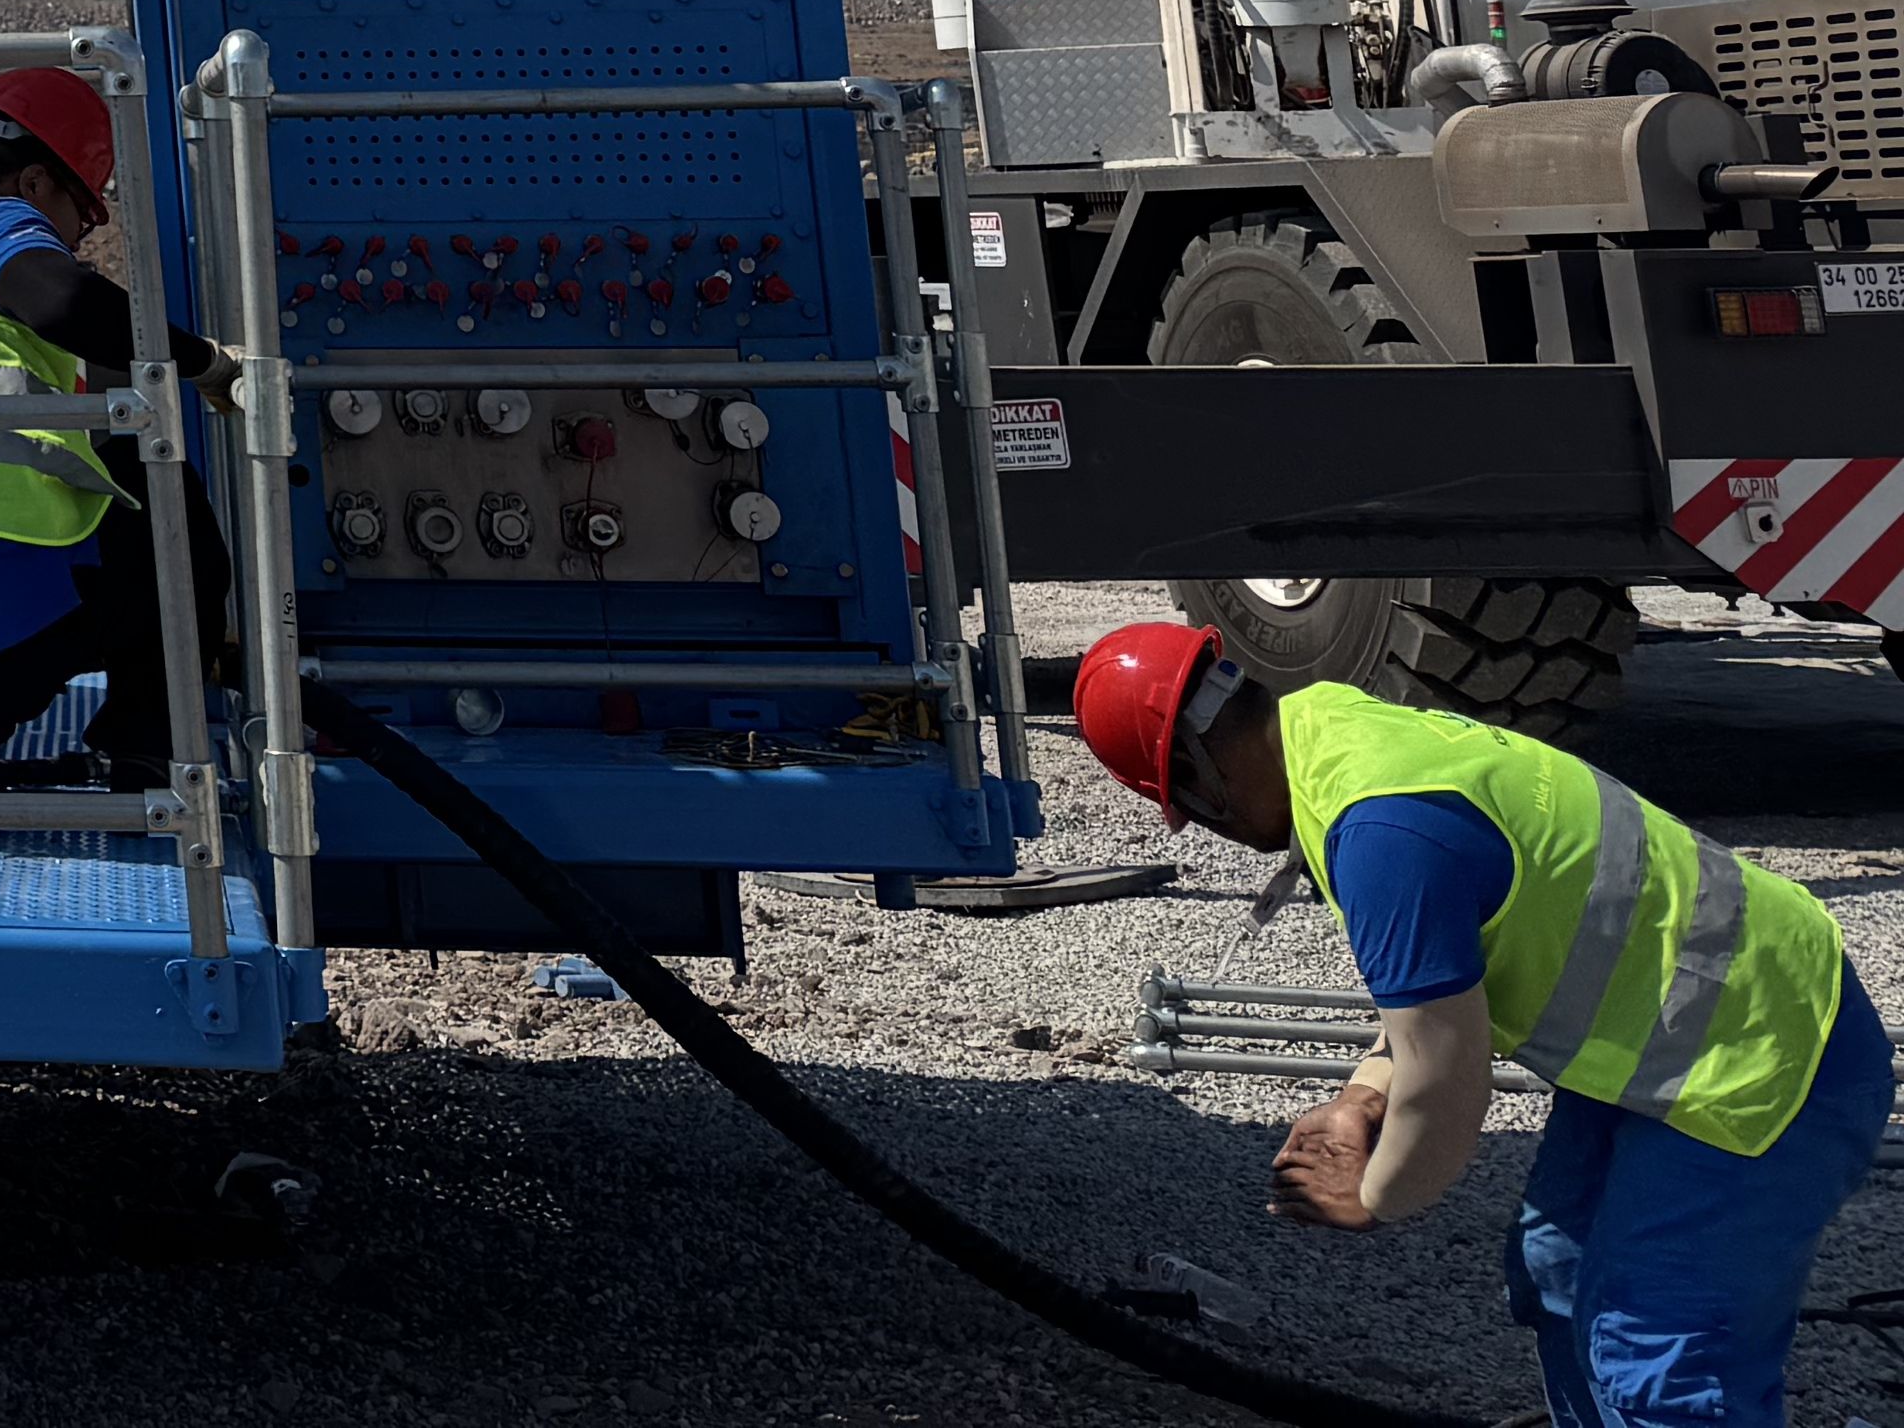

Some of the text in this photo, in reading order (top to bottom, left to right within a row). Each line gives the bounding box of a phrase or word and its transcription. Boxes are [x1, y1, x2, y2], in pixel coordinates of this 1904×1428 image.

[1822, 267, 1846, 286] 34
[1854, 267, 1878, 286] 00
[993, 427, 1059, 442] METREDEN
[1749, 478, 1780, 499] PIN
